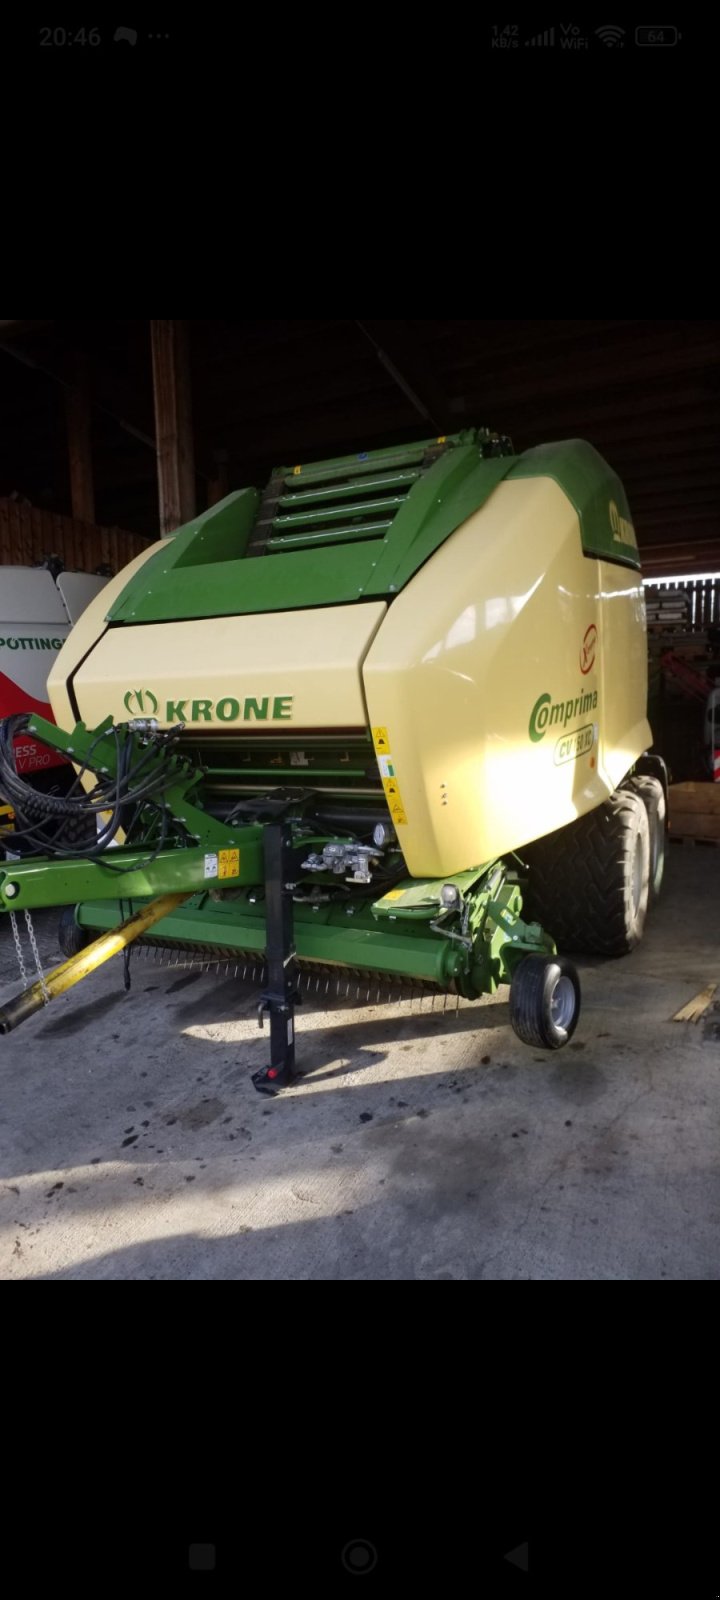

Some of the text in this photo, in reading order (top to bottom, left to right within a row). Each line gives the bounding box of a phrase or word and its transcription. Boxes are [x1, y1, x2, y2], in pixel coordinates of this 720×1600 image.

[166, 696, 294, 723] KRONE
[528, 688, 598, 743] Comprima
[29, 753, 50, 768] PRO
